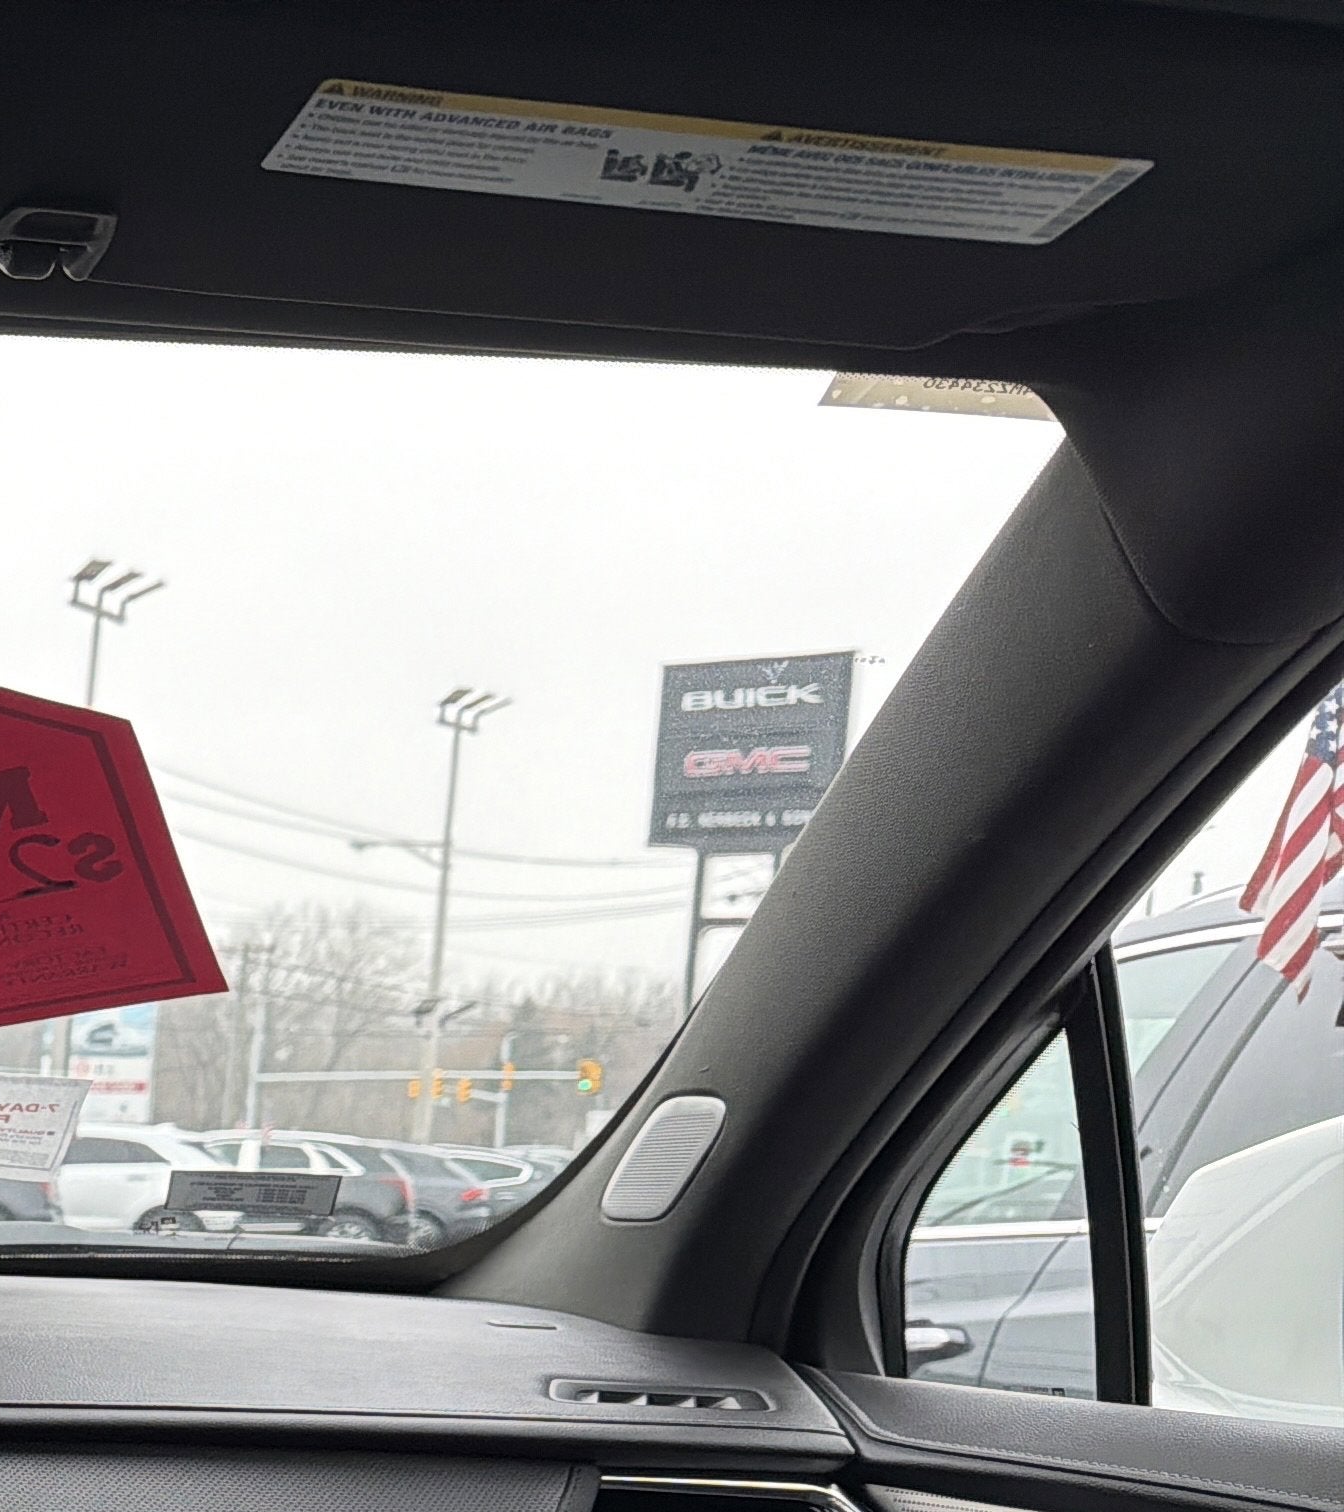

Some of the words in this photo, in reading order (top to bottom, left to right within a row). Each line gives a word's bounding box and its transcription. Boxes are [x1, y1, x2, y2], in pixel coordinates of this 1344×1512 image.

[314, 98, 364, 114] EVEN
[368, 105, 416, 120] WITH
[419, 112, 522, 131] ADVANCED
[525, 122, 560, 135] AIR
[681, 683, 824, 711] BUICK
[683, 746, 811, 778] GMC
